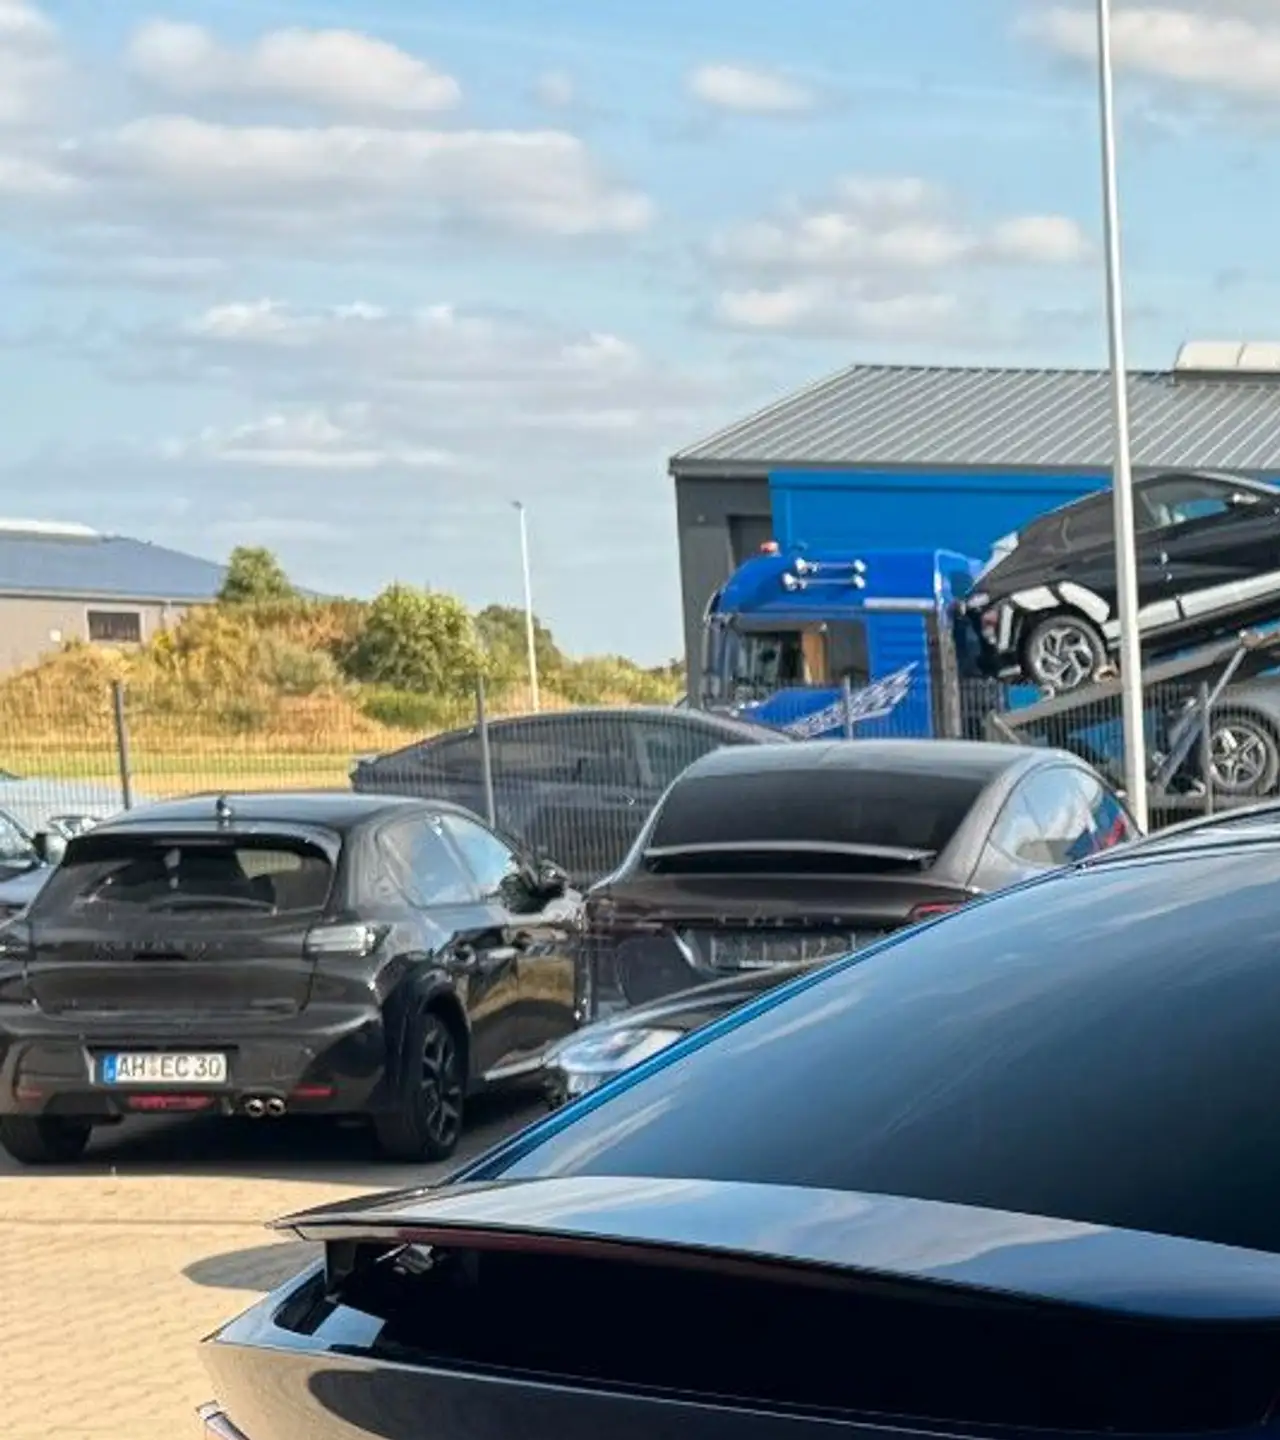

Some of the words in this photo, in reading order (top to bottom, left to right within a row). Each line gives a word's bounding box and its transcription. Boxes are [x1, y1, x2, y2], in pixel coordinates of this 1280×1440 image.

[118, 1056, 145, 1077] AH
[161, 1056, 188, 1077] EC
[194, 1056, 221, 1077] 30
